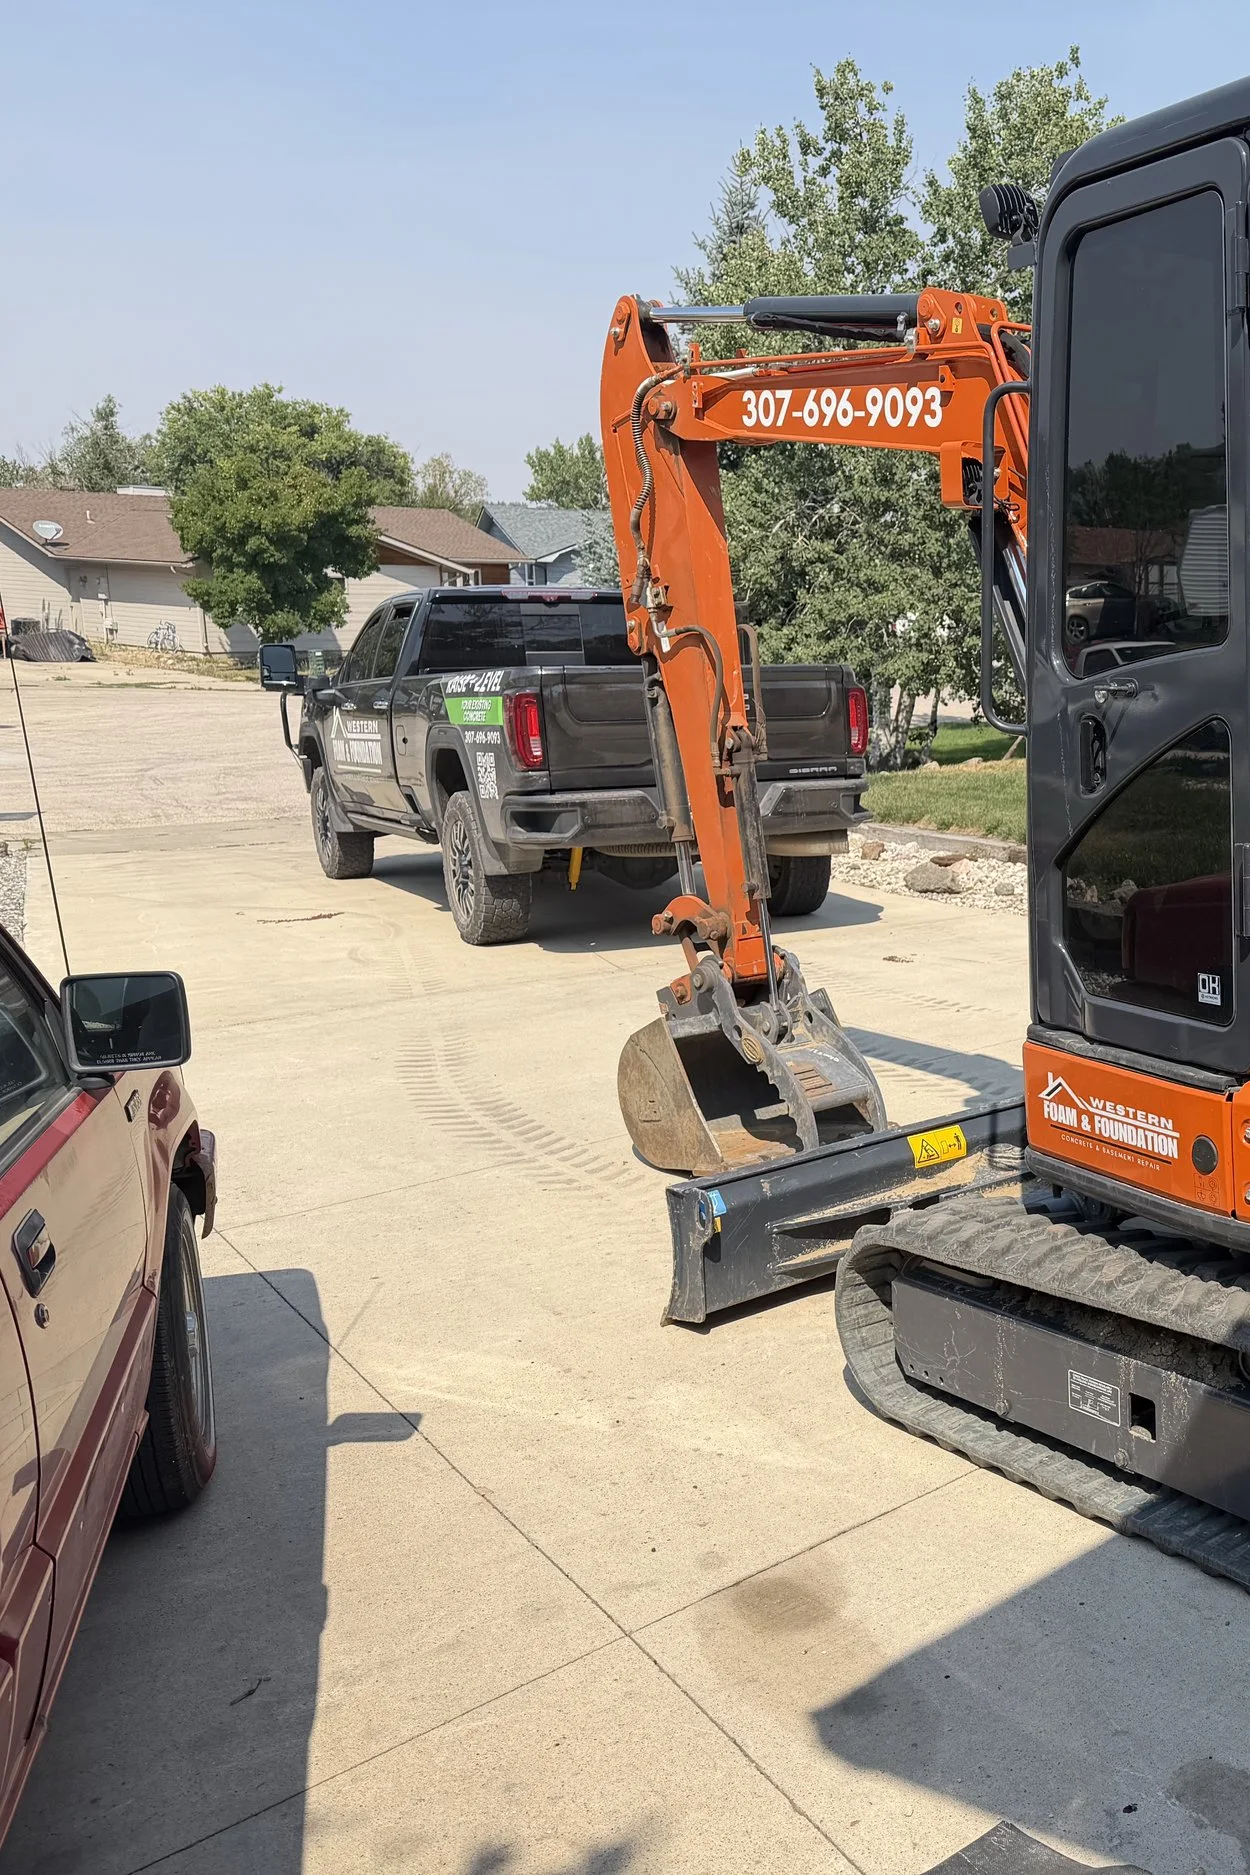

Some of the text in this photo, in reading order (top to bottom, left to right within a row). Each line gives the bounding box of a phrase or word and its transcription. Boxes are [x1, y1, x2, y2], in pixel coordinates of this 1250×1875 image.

[742, 387, 943, 428] 307-696-9093
[446, 674, 475, 693] RAISE
[474, 670, 504, 692] LEVEL
[347, 720, 378, 733] WESTERN
[465, 731, 501, 744] 307-696-9093
[788, 766, 838, 774] SIERRA
[1199, 975, 1219, 995] OK
[1089, 1096, 1173, 1130] WESTERN
[1043, 1100, 1178, 1160] FOAM & FOUNDATION
[1061, 1133, 1093, 1149] CONCRETE
[1102, 1146, 1135, 1163] BASEMENT
[1137, 1158, 1161, 1171] REPAIR
